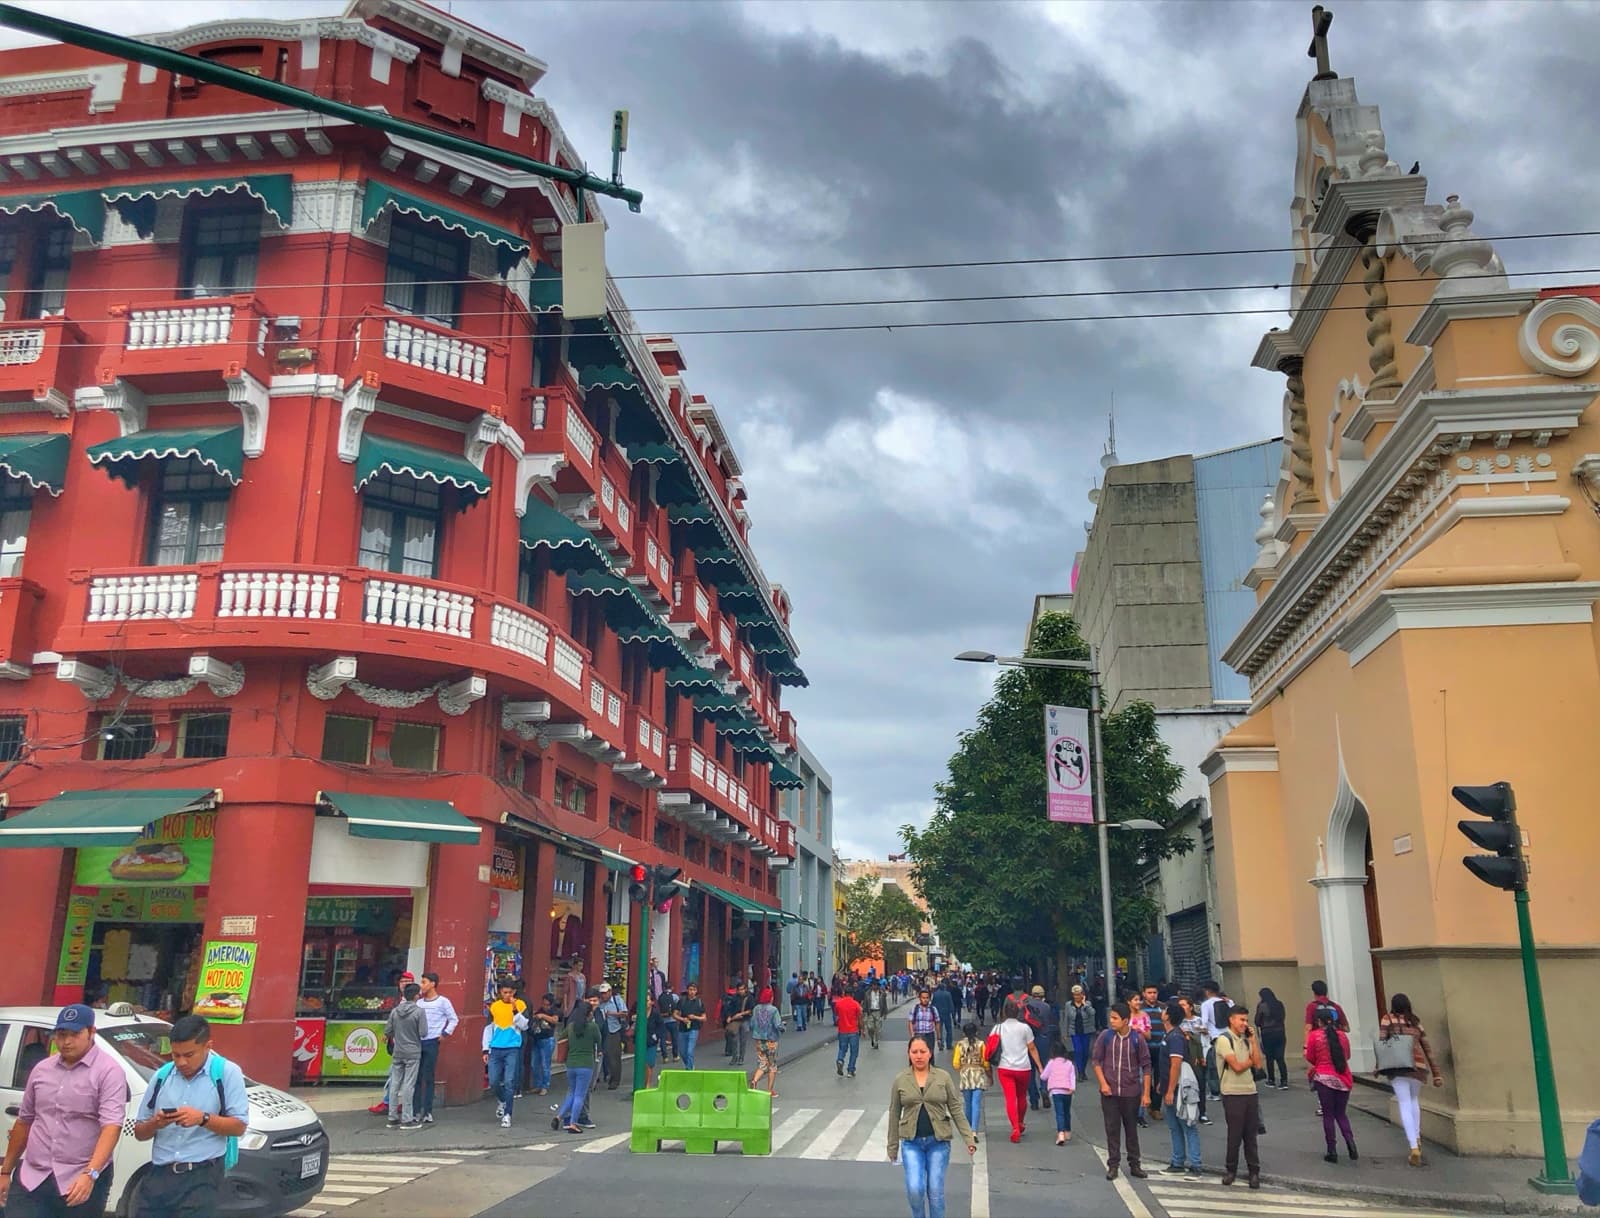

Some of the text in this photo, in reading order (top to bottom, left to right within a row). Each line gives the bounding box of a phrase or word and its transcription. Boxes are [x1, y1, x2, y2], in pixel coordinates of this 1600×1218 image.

[332, 910, 357, 922] LUZ
[207, 945, 252, 966] AMERICAN
[205, 969, 244, 988] HOT DOG
